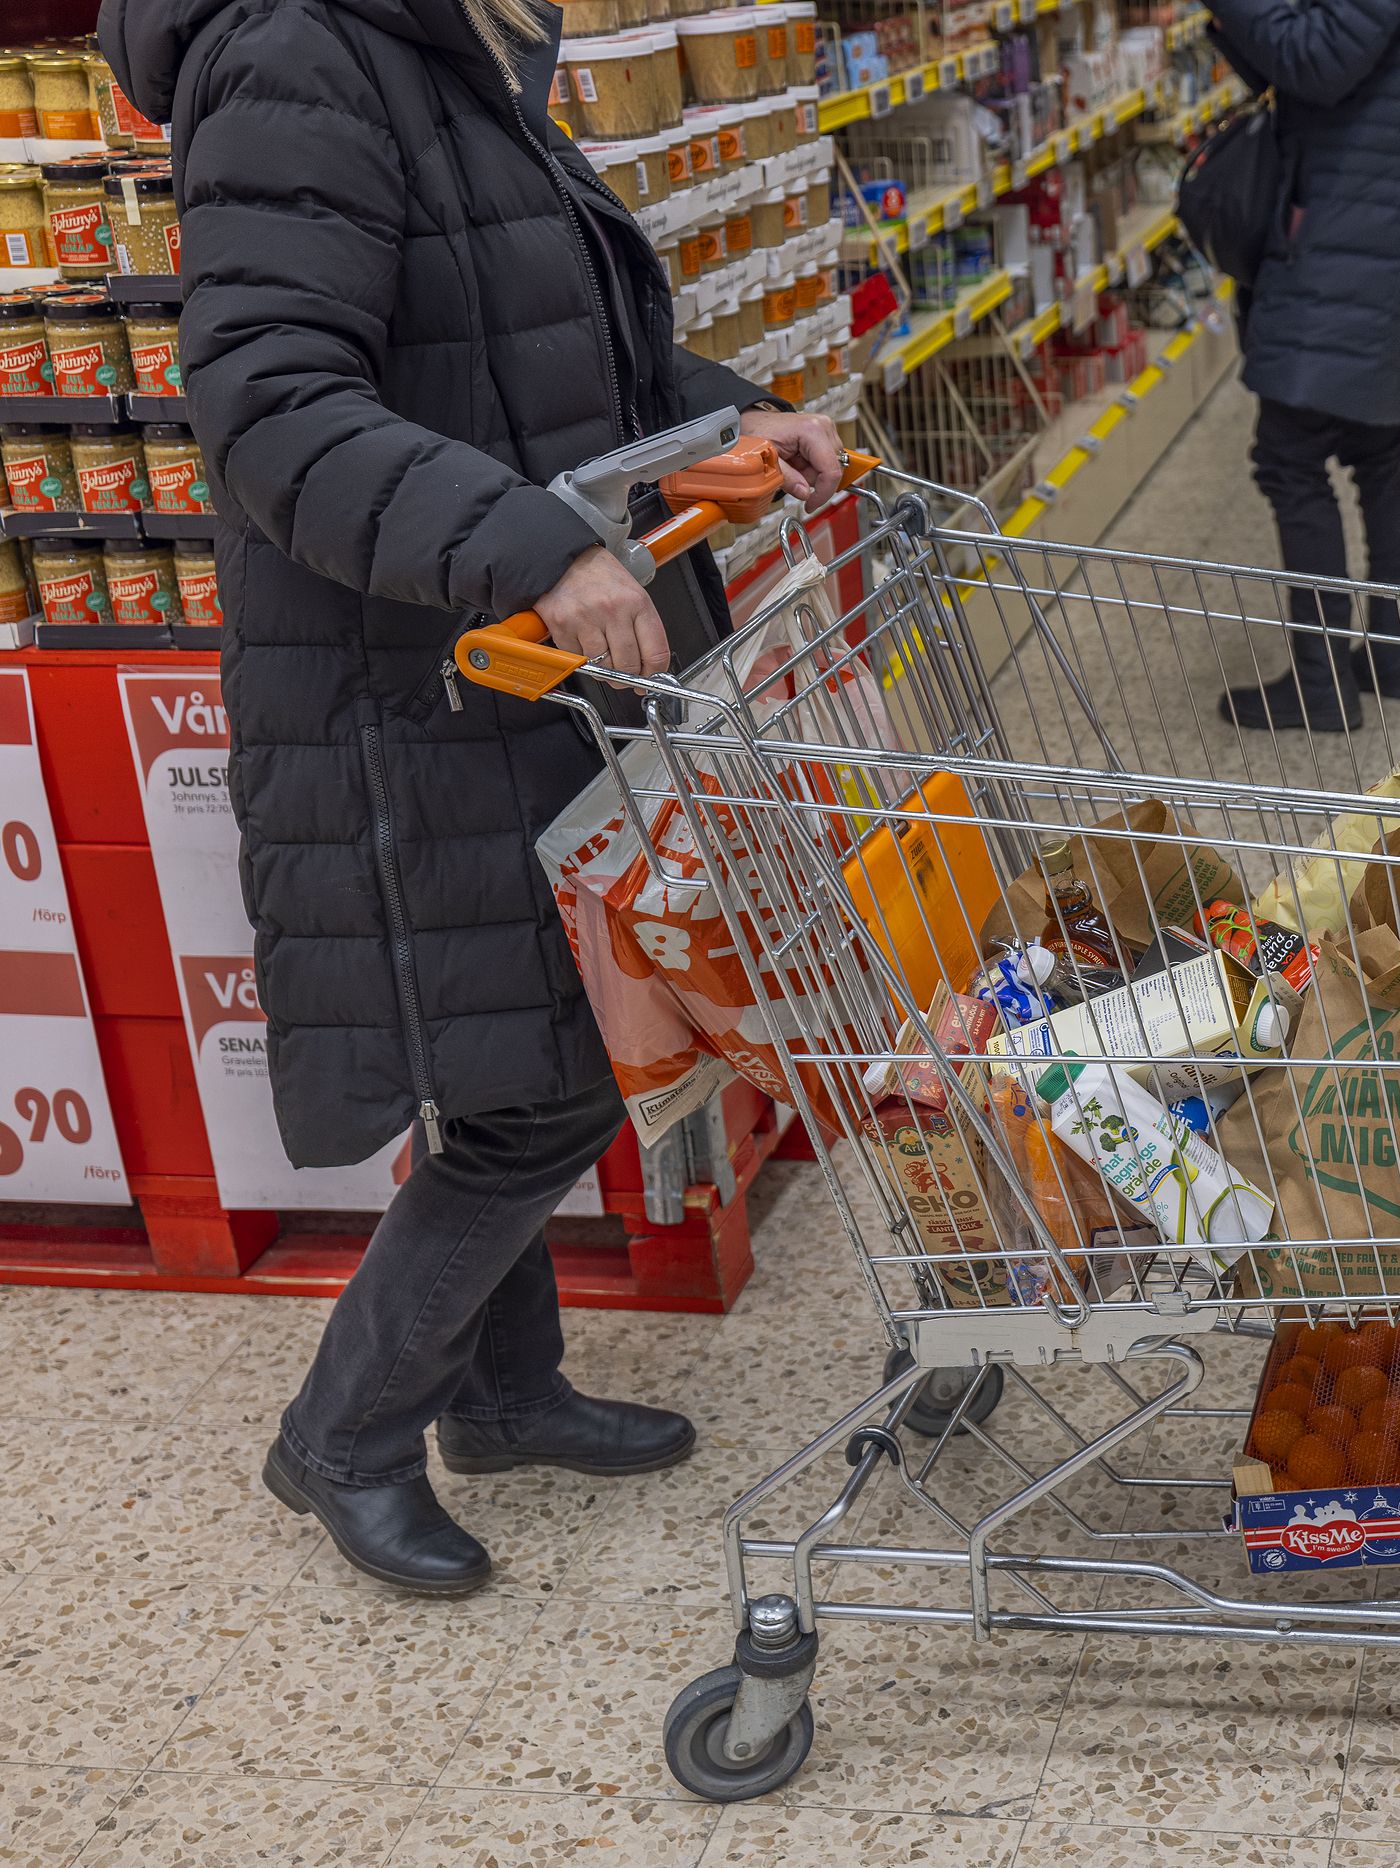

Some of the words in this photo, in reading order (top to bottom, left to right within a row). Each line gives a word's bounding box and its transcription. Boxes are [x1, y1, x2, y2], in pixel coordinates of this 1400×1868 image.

[53, 209, 98, 236] Johnny's
[0, 346, 43, 371] ohnny's
[53, 351, 99, 376] Johnny's
[82, 466, 132, 493] Johnny's
[219, 1037, 267, 1052] SENA
[1320, 1122, 1399, 1168] MIG
[1101, 1153, 1124, 1176] mat
[906, 1190, 978, 1214] eko
[948, 1216, 974, 1225] SENSK
[1286, 1527, 1364, 1554] KissMe
[1327, 1544, 1351, 1552] sweet!
